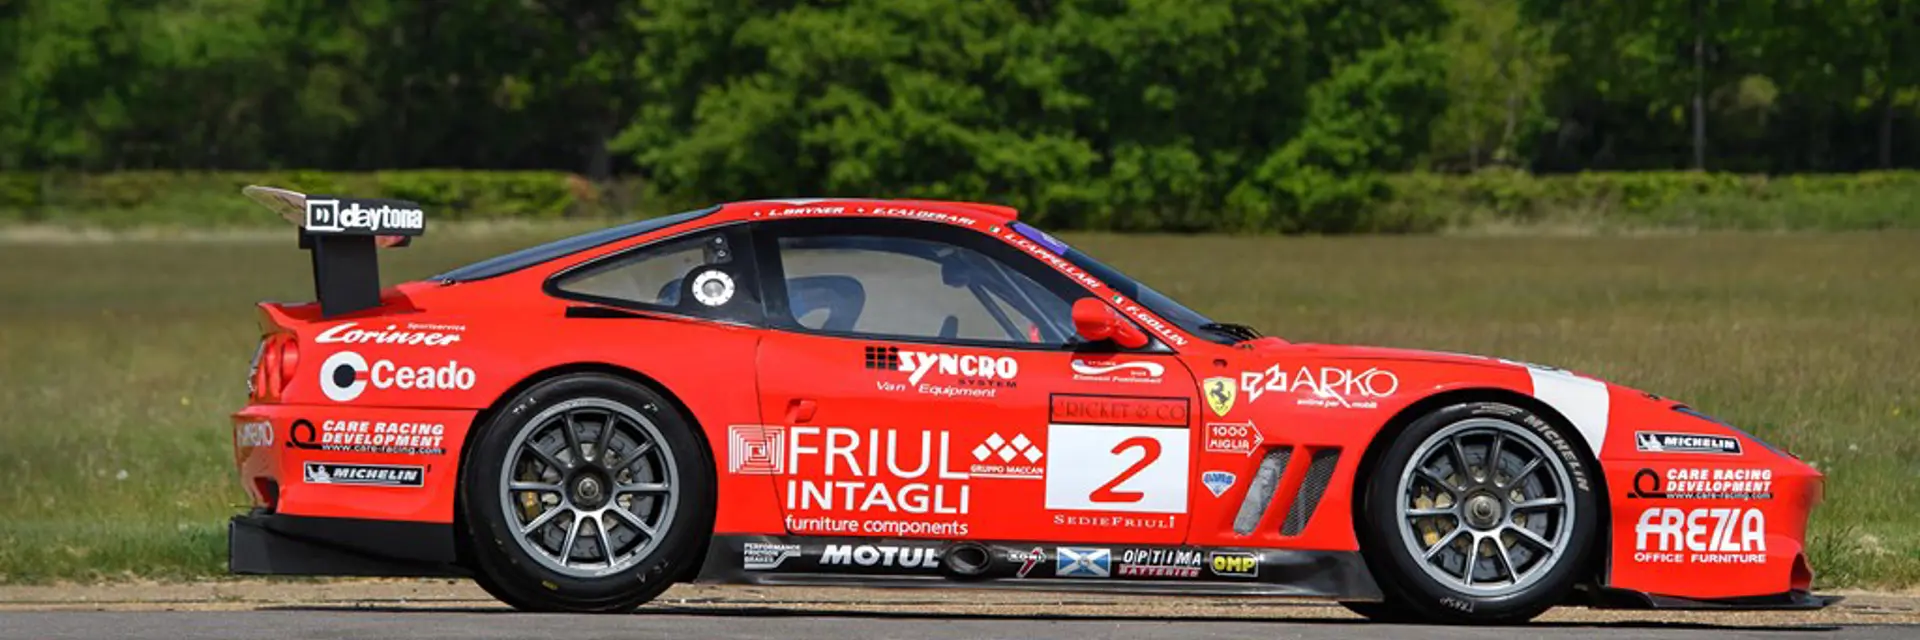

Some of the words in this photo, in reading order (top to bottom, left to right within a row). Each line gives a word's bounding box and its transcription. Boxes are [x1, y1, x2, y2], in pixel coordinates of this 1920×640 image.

[340, 203, 423, 231] daytona
[314, 321, 461, 346] Lorinser
[371, 358, 476, 390] Ceado
[898, 351, 1018, 386] SYNCRO
[876, 381, 906, 392] Van
[918, 382, 996, 398] Equipment
[958, 379, 1017, 388] SYSTEM
[1290, 365, 1399, 400] ARKO
[1053, 401, 1131, 419] CRICKET
[1156, 404, 1186, 421] CO
[322, 420, 370, 433] CARE
[374, 422, 445, 436] RACING
[1212, 426, 1248, 437] 1000
[322, 432, 444, 448] DEVELOPMENT
[1209, 439, 1250, 450] MIGLIA
[1663, 436, 1736, 450] MICHELIN
[788, 426, 970, 480] FRIUL
[1524, 414, 1591, 493] MICHELIN
[333, 467, 418, 481] MICHELIN
[1088, 435, 1163, 503] 2
[1666, 468, 1709, 480] CARE
[1713, 468, 1772, 481] RACING
[1666, 480, 1772, 492] DEVELOPMENT
[786, 480, 970, 514] INTAGLI
[785, 515, 860, 533] furniture
[863, 518, 969, 537] components
[1635, 507, 1767, 552] FREZZA
[819, 544, 940, 568] MOTUL
[1123, 549, 1200, 565] OPTIMA
[1213, 555, 1256, 572] OMP
[1634, 552, 1684, 563] OFFICE
[1691, 553, 1767, 564] FURNITURE
